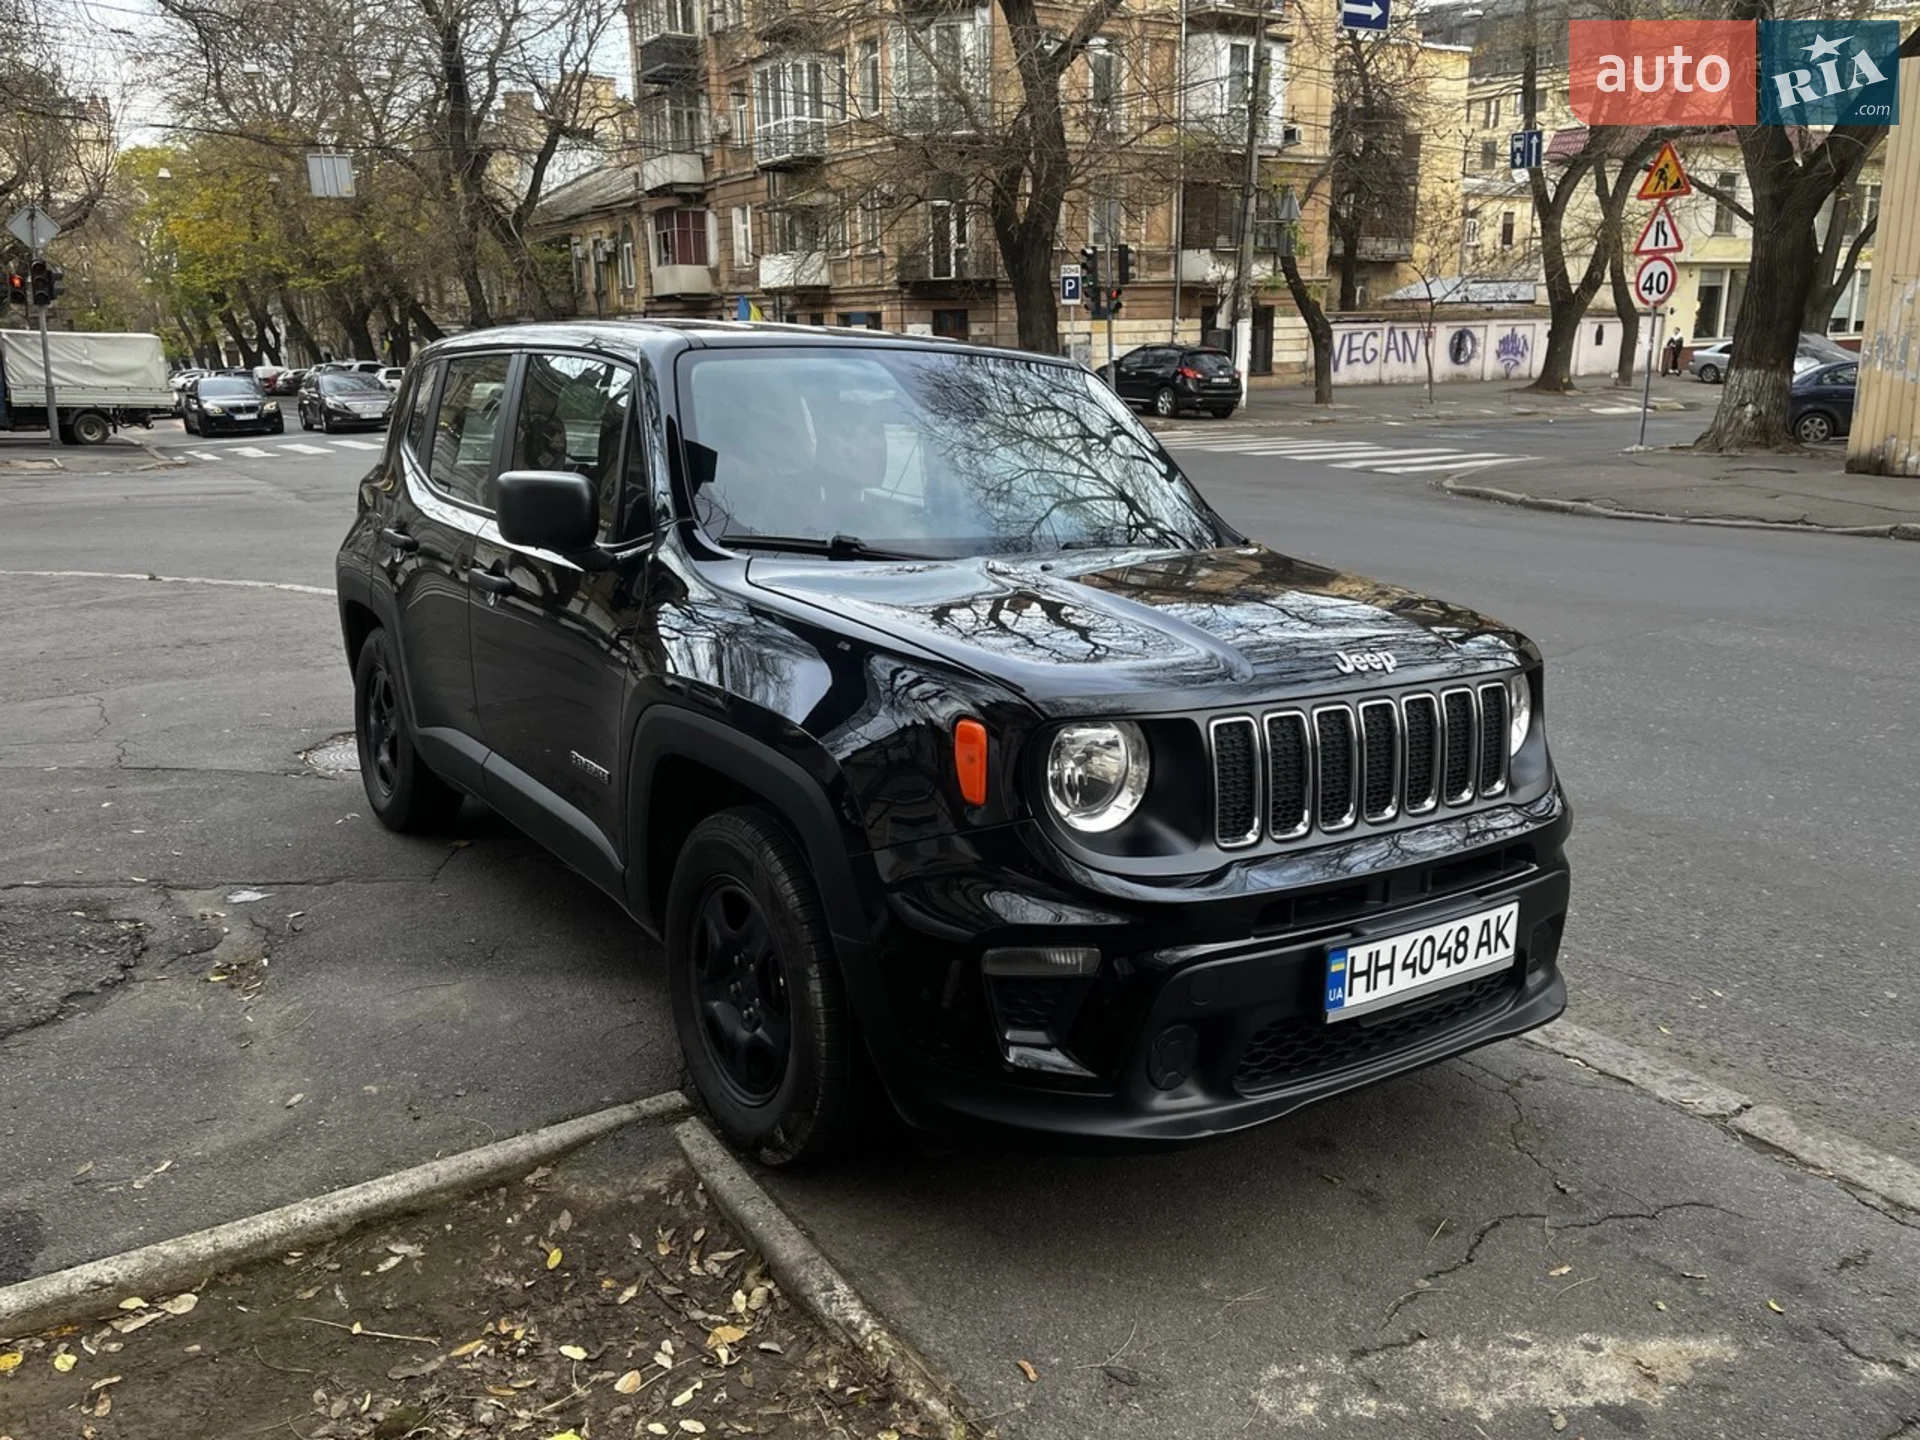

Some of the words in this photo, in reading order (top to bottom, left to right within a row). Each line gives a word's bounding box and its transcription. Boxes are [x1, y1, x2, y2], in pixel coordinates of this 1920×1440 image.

[1065, 279, 1075, 297] P
[1642, 271, 1669, 295] 40
[1329, 326, 1421, 373] VEGAN
[1335, 650, 1398, 675] Jeep
[1348, 945, 1397, 998] HH
[1401, 925, 1470, 979] 4048
[1474, 910, 1515, 960] AK
[1328, 986, 1343, 1001] UA
